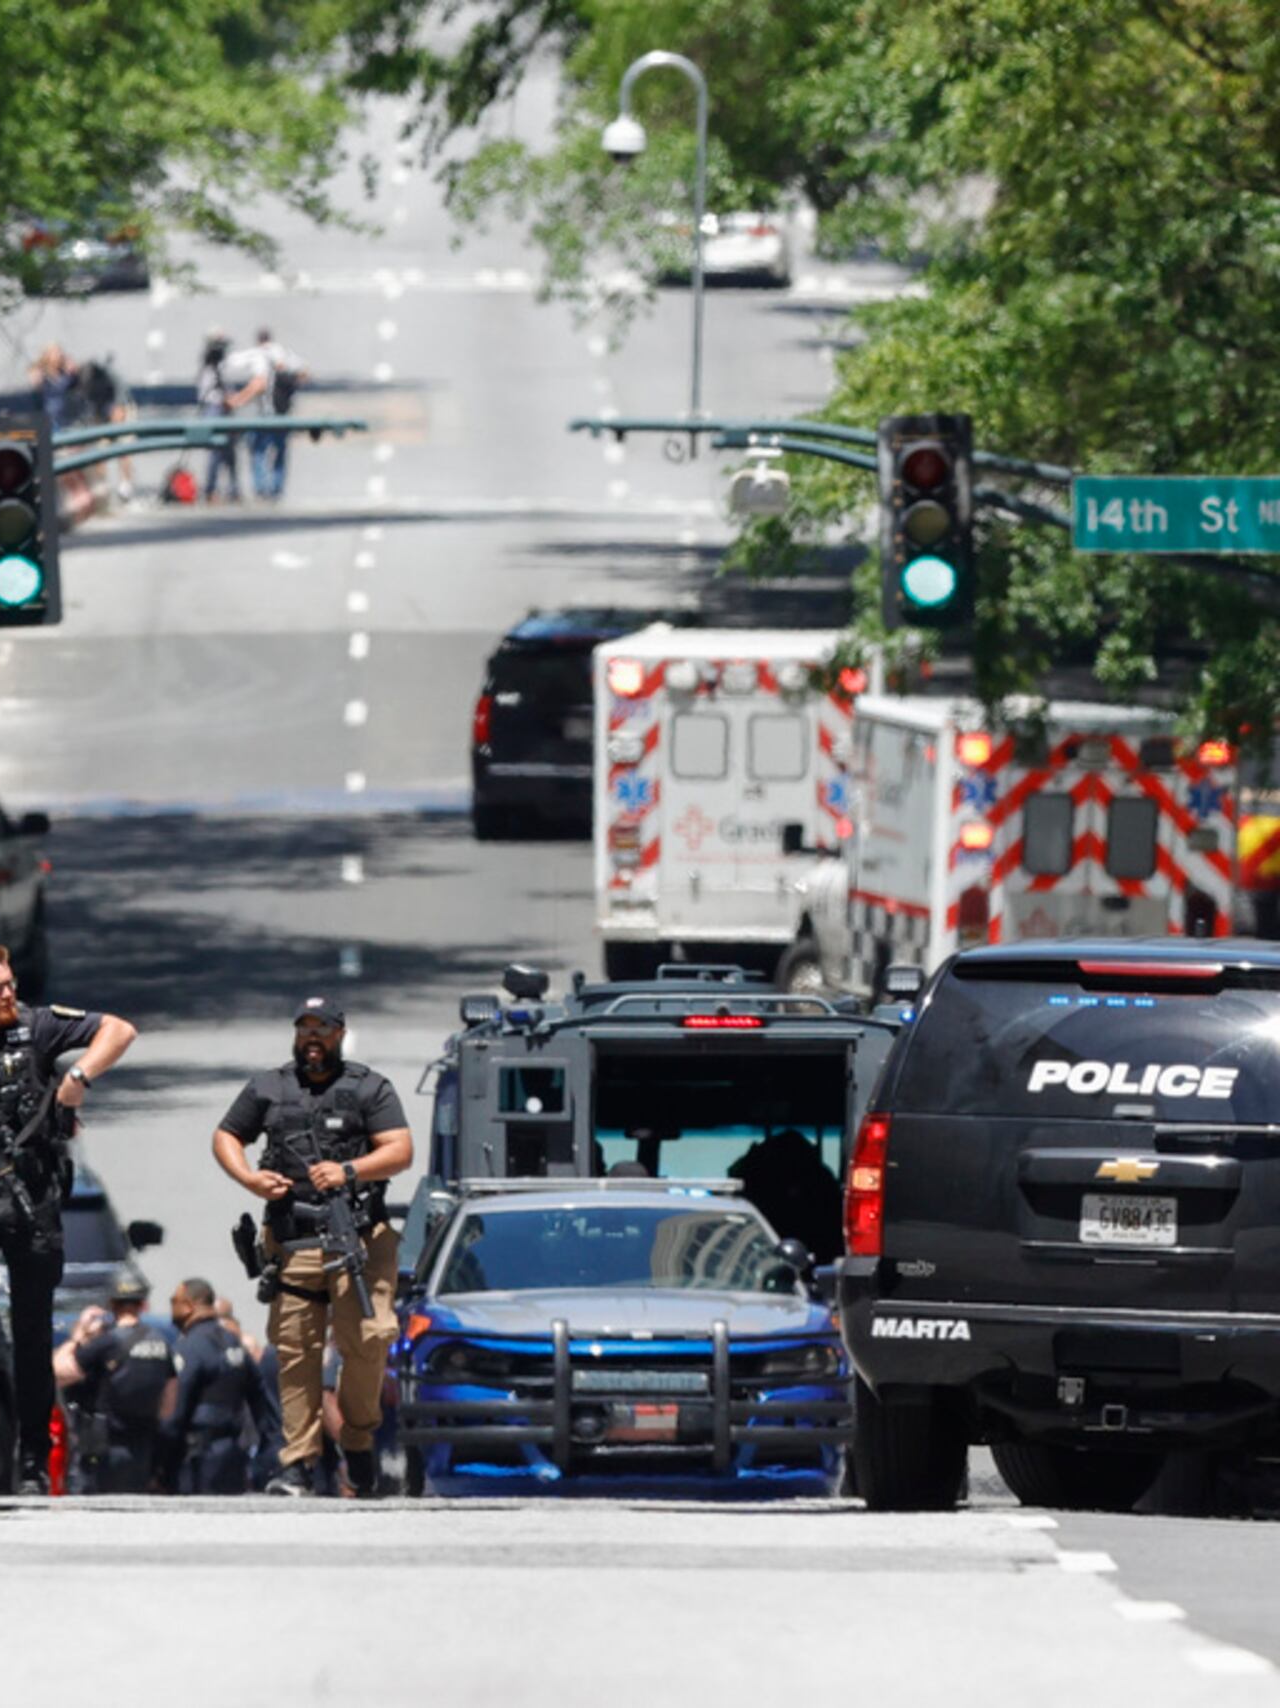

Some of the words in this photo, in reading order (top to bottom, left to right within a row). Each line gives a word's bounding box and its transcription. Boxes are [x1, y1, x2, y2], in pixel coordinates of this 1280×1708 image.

[1086, 497, 1169, 534] 14th
[1199, 495, 1241, 534] St
[1028, 1060, 1239, 1098] POLICE
[871, 1317, 971, 1341] MARTA
